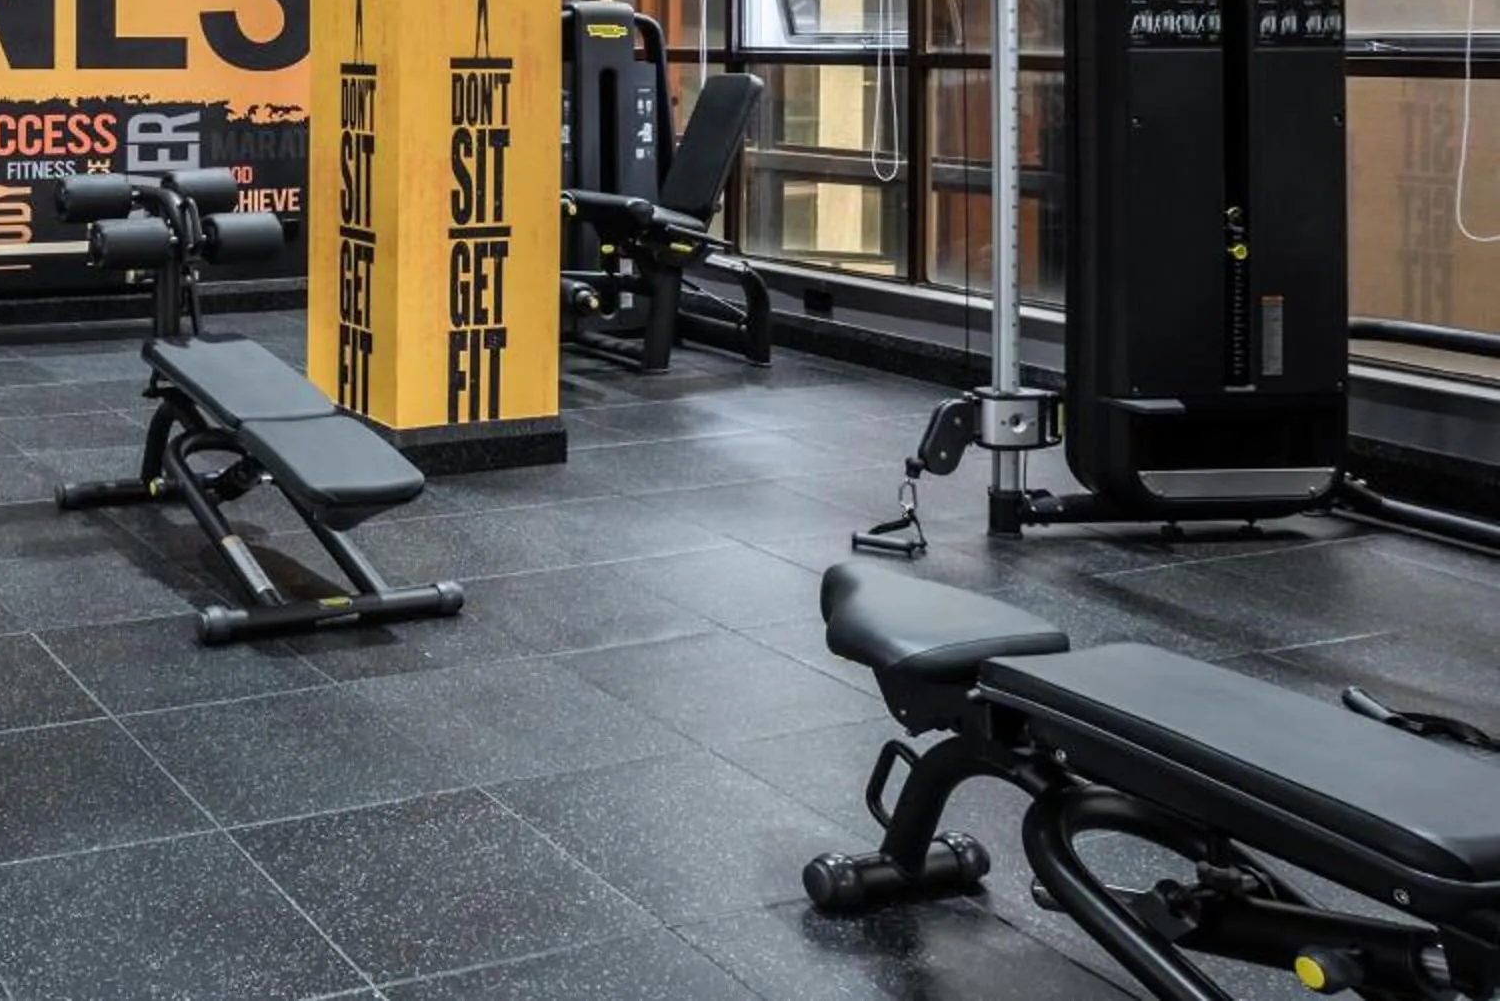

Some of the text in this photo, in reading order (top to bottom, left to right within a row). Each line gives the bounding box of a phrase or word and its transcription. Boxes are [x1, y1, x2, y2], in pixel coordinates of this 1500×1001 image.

[341, 77, 376, 132] DON'T
[451, 72, 510, 126] DON'T
[7, 160, 76, 181] FITNESS
[340, 130, 375, 228] SIT
[450, 127, 510, 224] SIT
[340, 239, 374, 329] GET
[449, 240, 509, 328] GET
[338, 321, 373, 415] FIT
[447, 327, 507, 424] FIT
